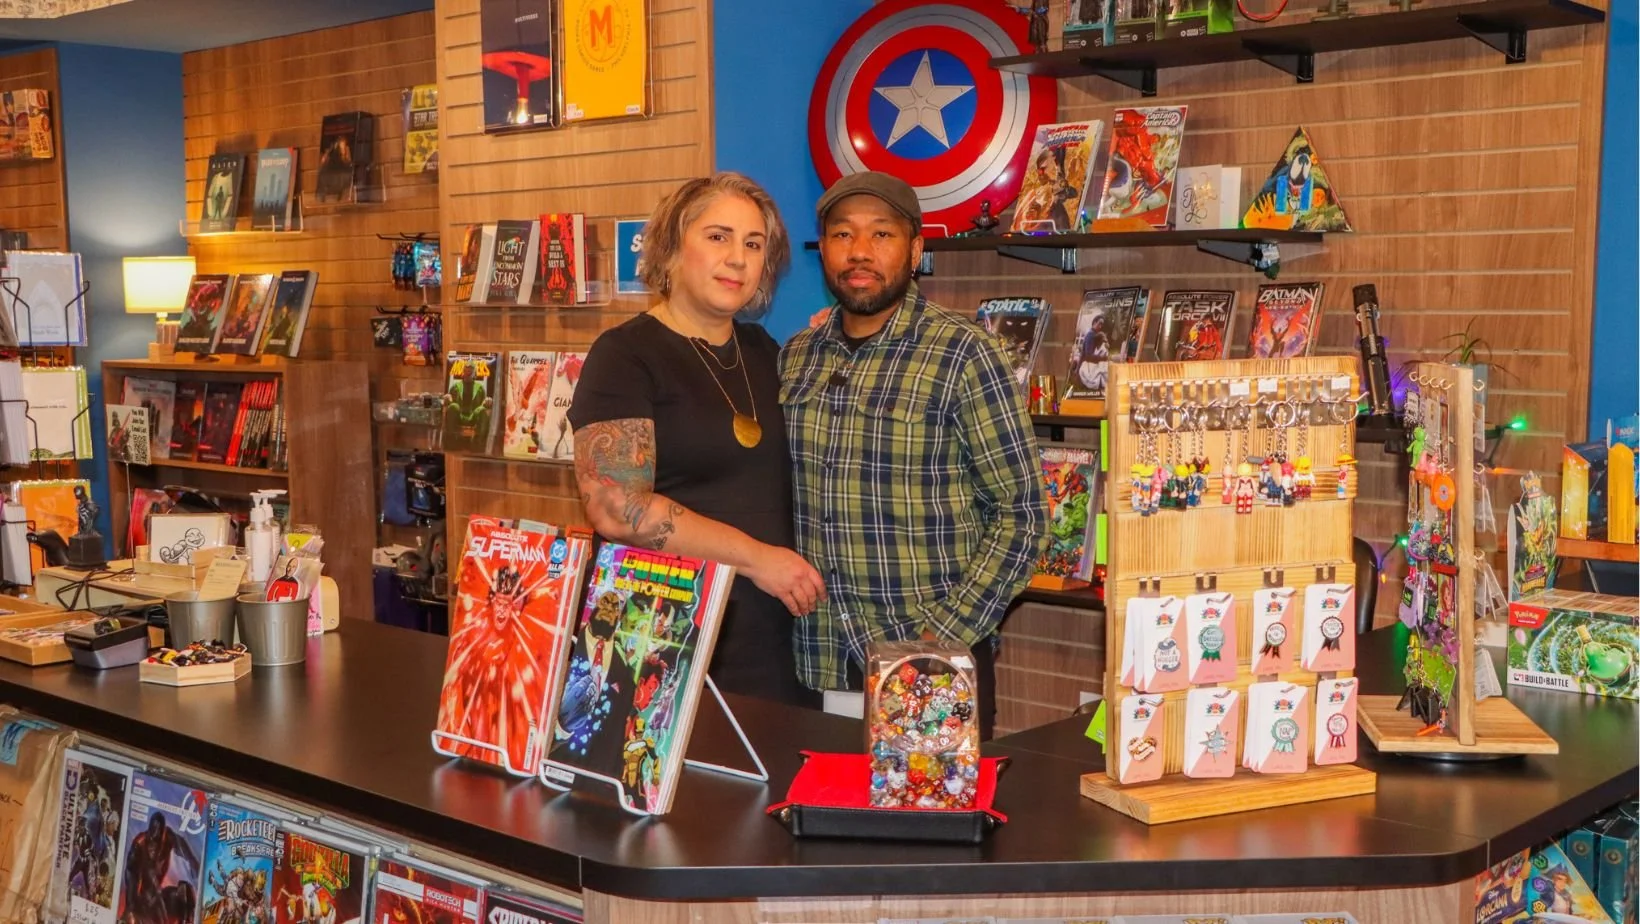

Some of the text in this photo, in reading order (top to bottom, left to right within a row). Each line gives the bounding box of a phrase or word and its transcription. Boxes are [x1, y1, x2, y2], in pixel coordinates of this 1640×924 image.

[590, 5, 613, 48] M
[498, 239, 526, 257] LIGHT
[492, 270, 521, 288] STARS
[1257, 287, 1316, 303] BATMAN
[987, 299, 1031, 314] STATIC
[1166, 301, 1228, 313] TASK
[490, 530, 528, 543] ABSOLUTE
[465, 536, 547, 565] SUPERMAN
[619, 550, 697, 590] POWER
[1546, 677, 1569, 688] BATTLE
[62, 793, 76, 860] ULTIMATE
[55, 820, 67, 869] PANTHER
[425, 889, 462, 908] ROBOTECH
[1476, 893, 1508, 924] LORCANA
